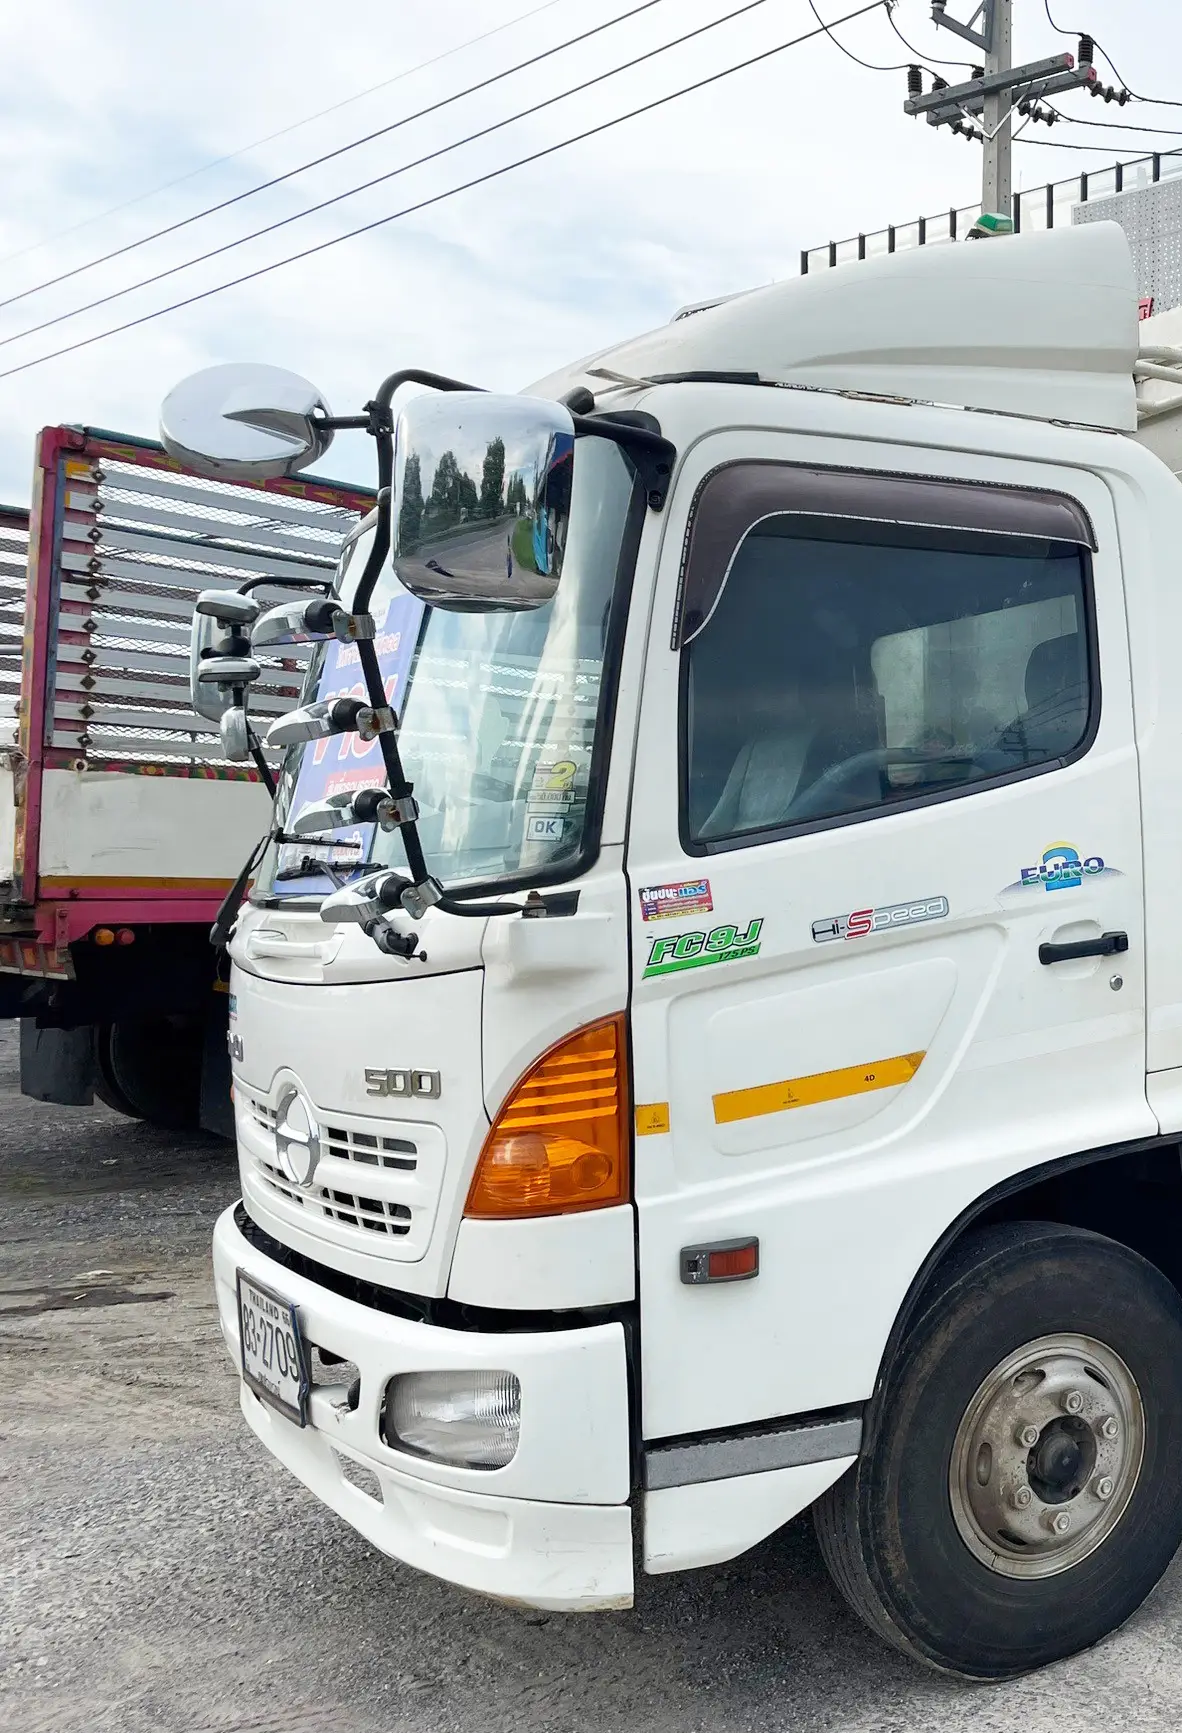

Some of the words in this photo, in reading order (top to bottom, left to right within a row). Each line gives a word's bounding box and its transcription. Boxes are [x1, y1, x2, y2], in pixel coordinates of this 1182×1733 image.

[534, 820, 557, 834] OK
[1020, 856, 1105, 886] EURO
[811, 897, 946, 940] Hi-Speed
[364, 1066, 442, 1100] 500
[243, 1303, 299, 1382] 83-2709
